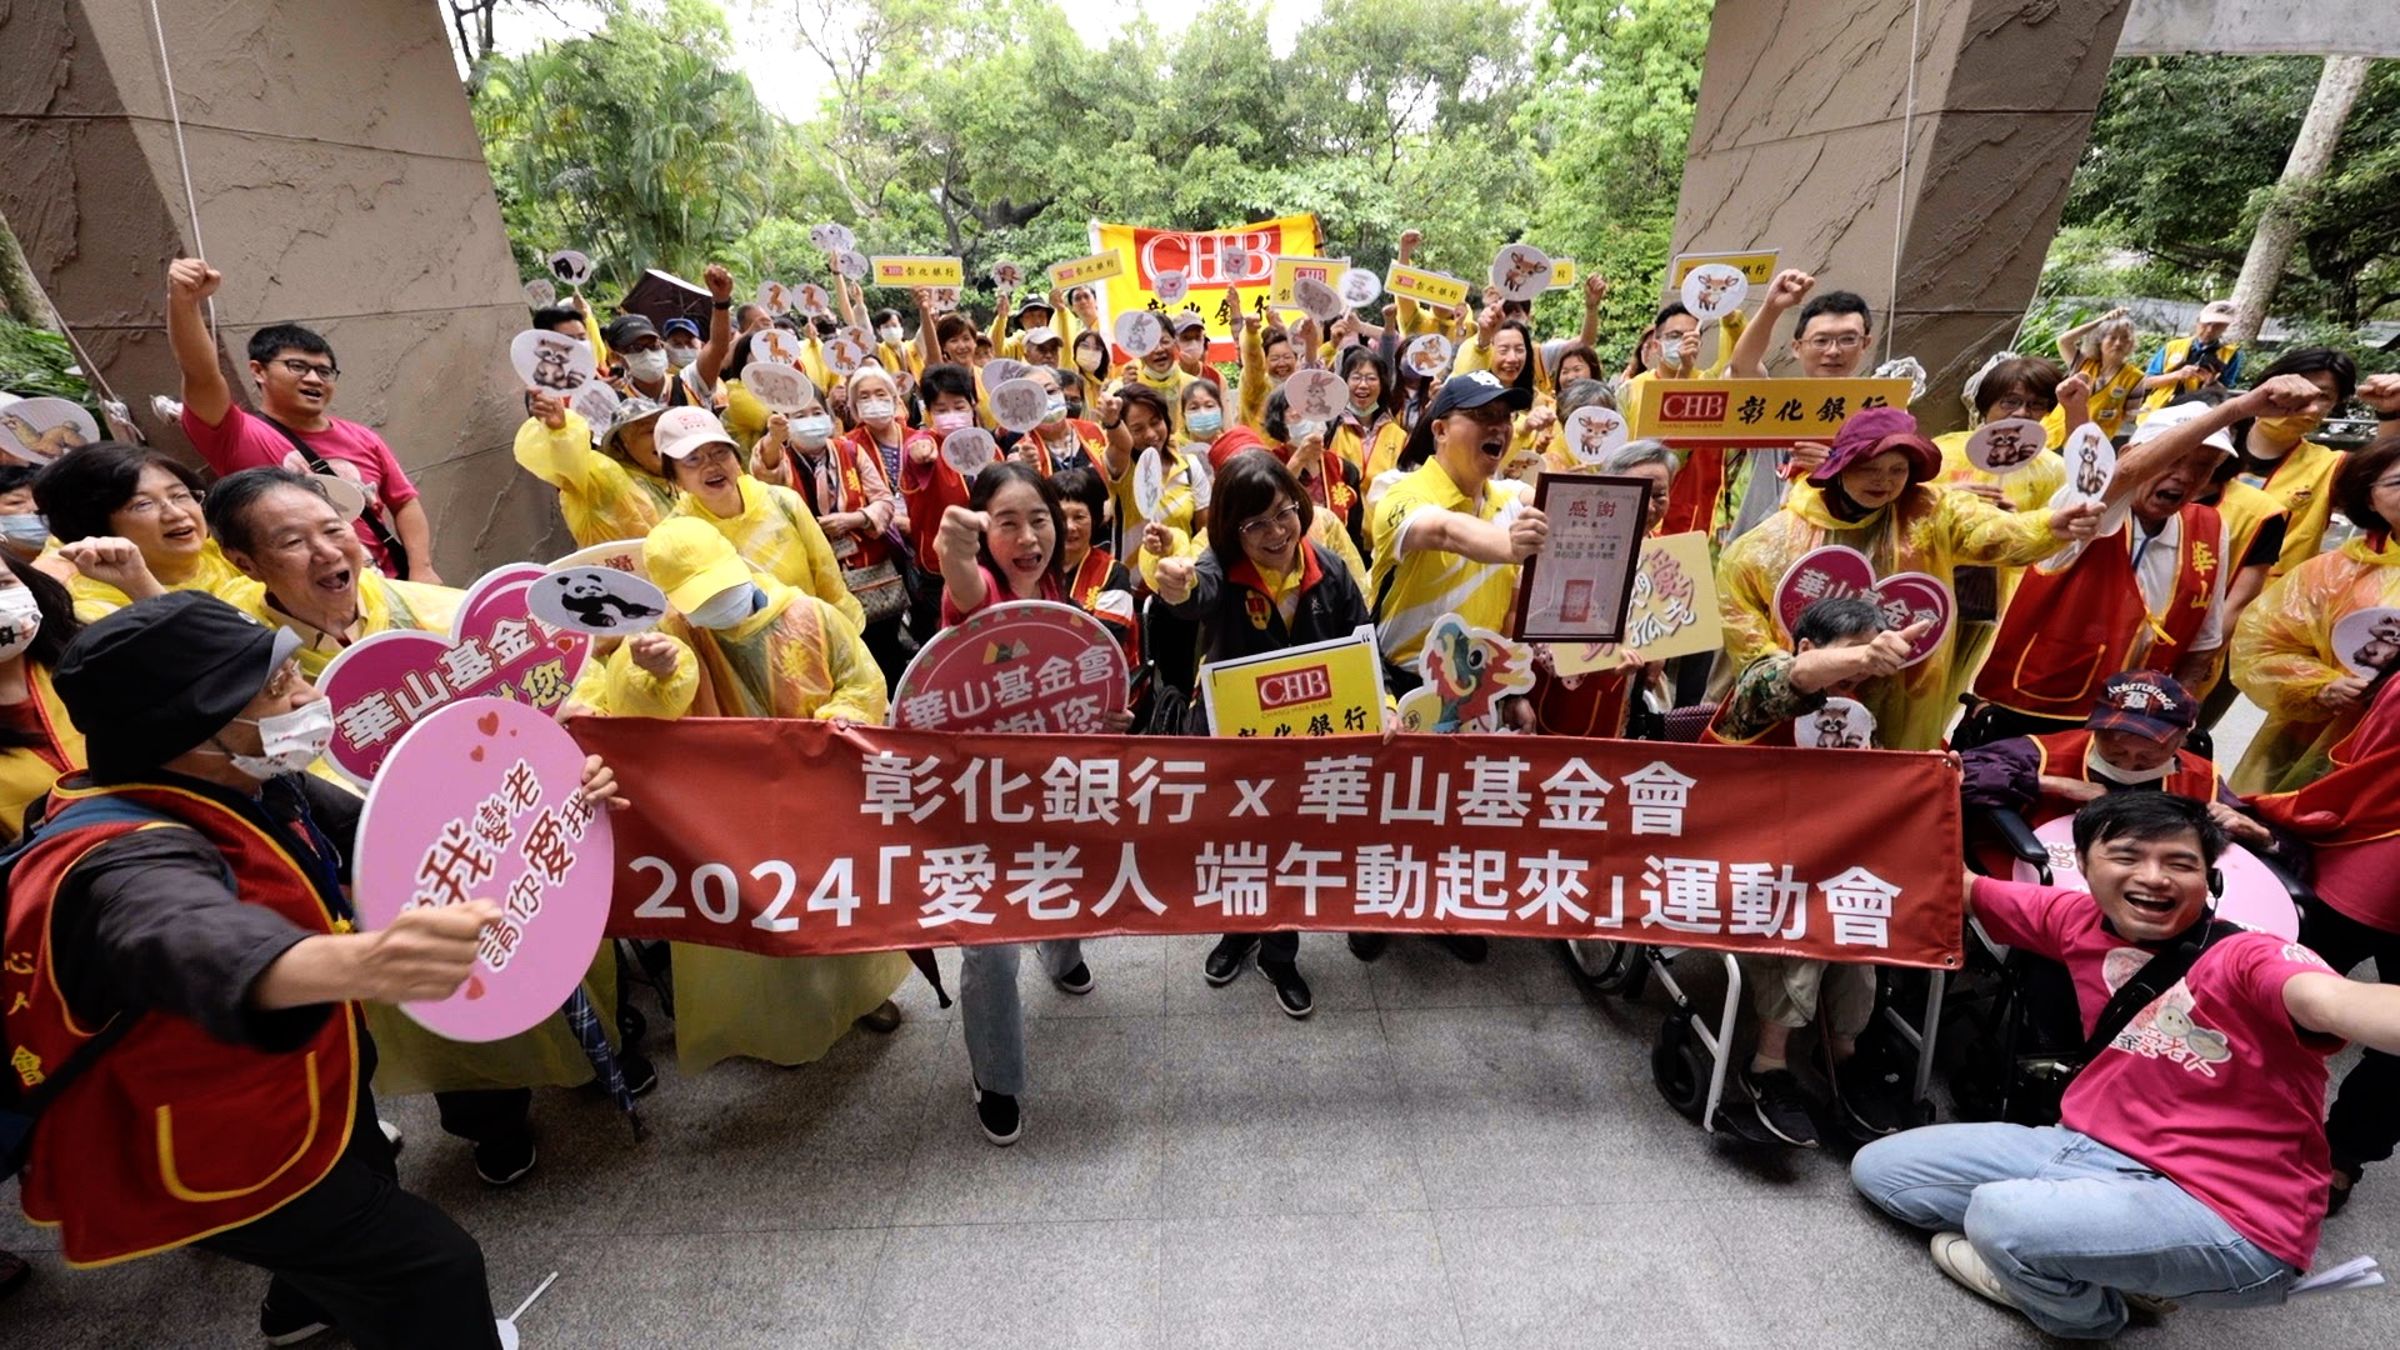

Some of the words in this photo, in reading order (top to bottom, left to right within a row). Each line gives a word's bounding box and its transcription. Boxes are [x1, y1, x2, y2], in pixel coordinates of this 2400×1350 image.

[1141, 231, 1275, 283] CHB
[1663, 395, 1723, 419] CHB
[1568, 500, 1617, 518] 感謝
[335, 613, 560, 750] 華山基金
[902, 644, 1114, 730] 華山基金會
[964, 694, 1104, 733] 謝您
[1260, 669, 1328, 706] CHB
[860, 751, 1206, 826] 彰化銀行
[1299, 754, 1698, 837] 華山基金會
[405, 763, 540, 912] 我變老
[1193, 841, 1903, 949] 端午動起來」運動會
